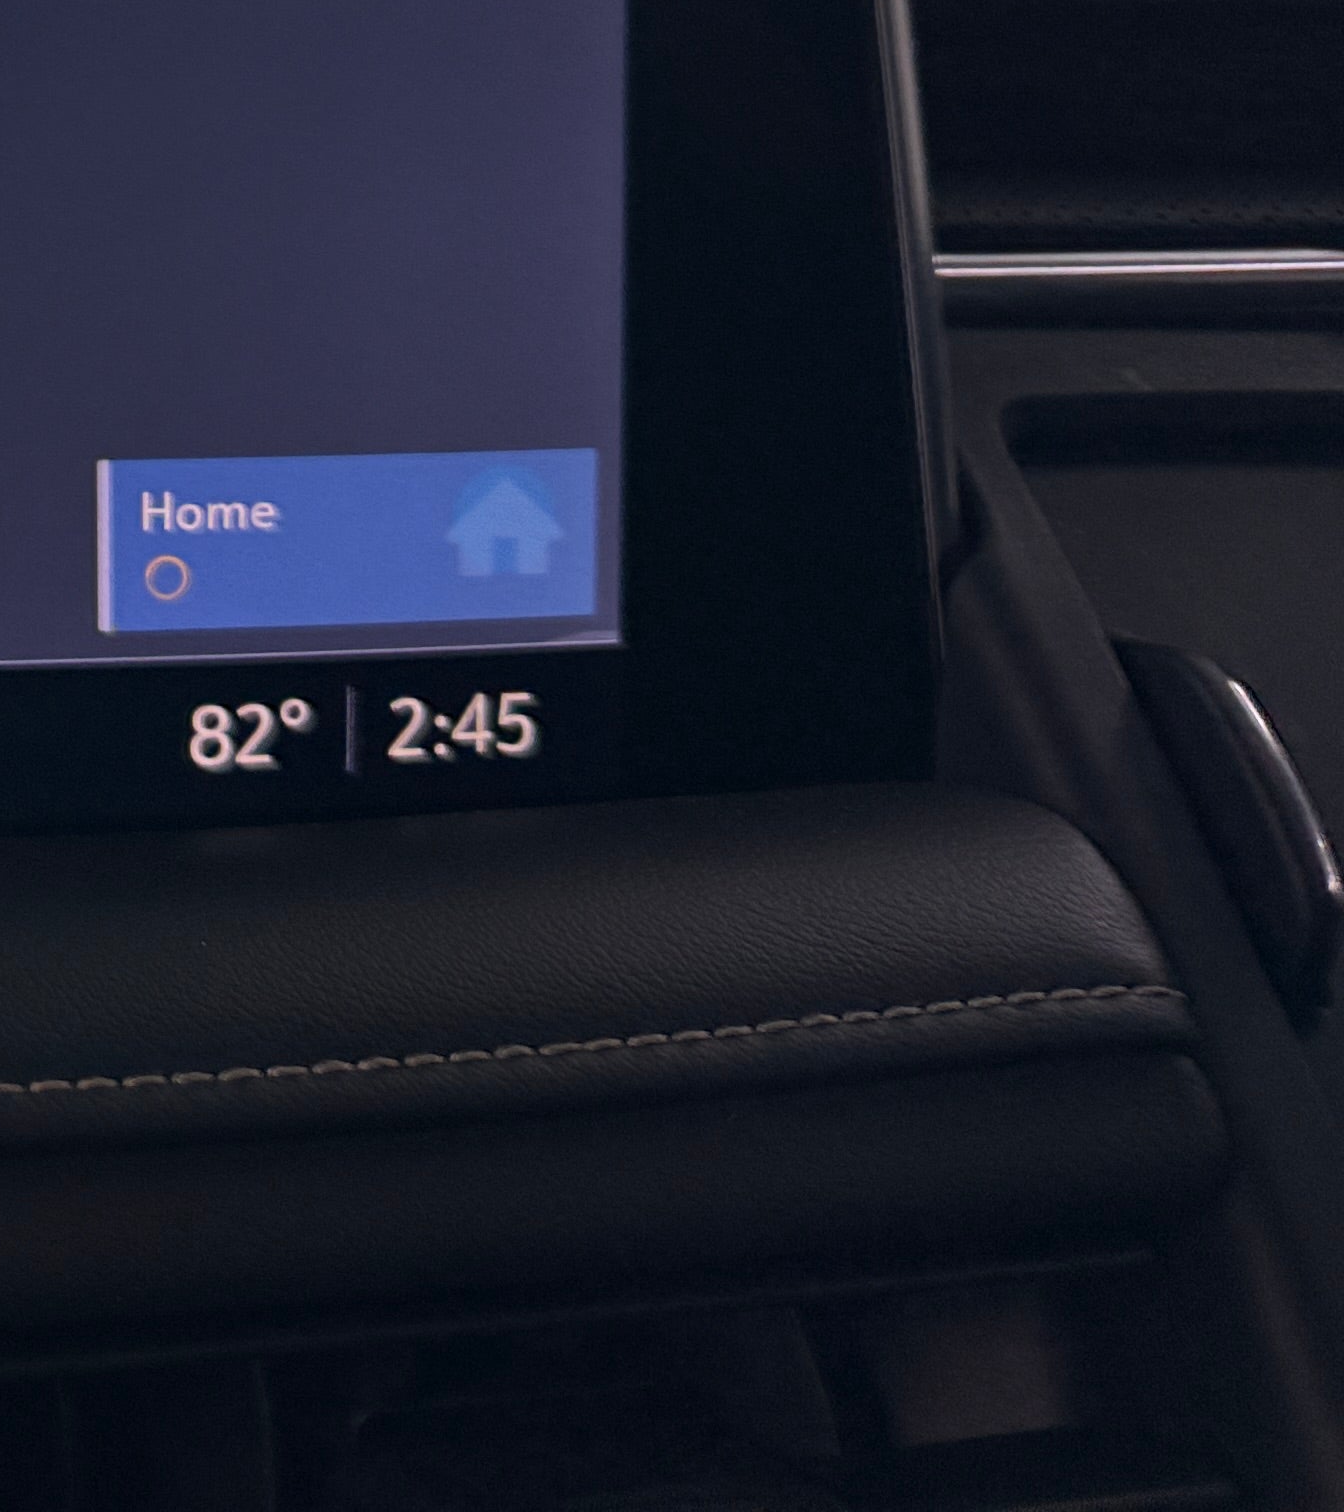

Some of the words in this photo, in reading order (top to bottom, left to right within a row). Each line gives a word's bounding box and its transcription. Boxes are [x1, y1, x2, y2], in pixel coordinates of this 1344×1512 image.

[141, 490, 280, 533] Home
[189, 697, 312, 771] 82°
[387, 691, 538, 762] 2:45
